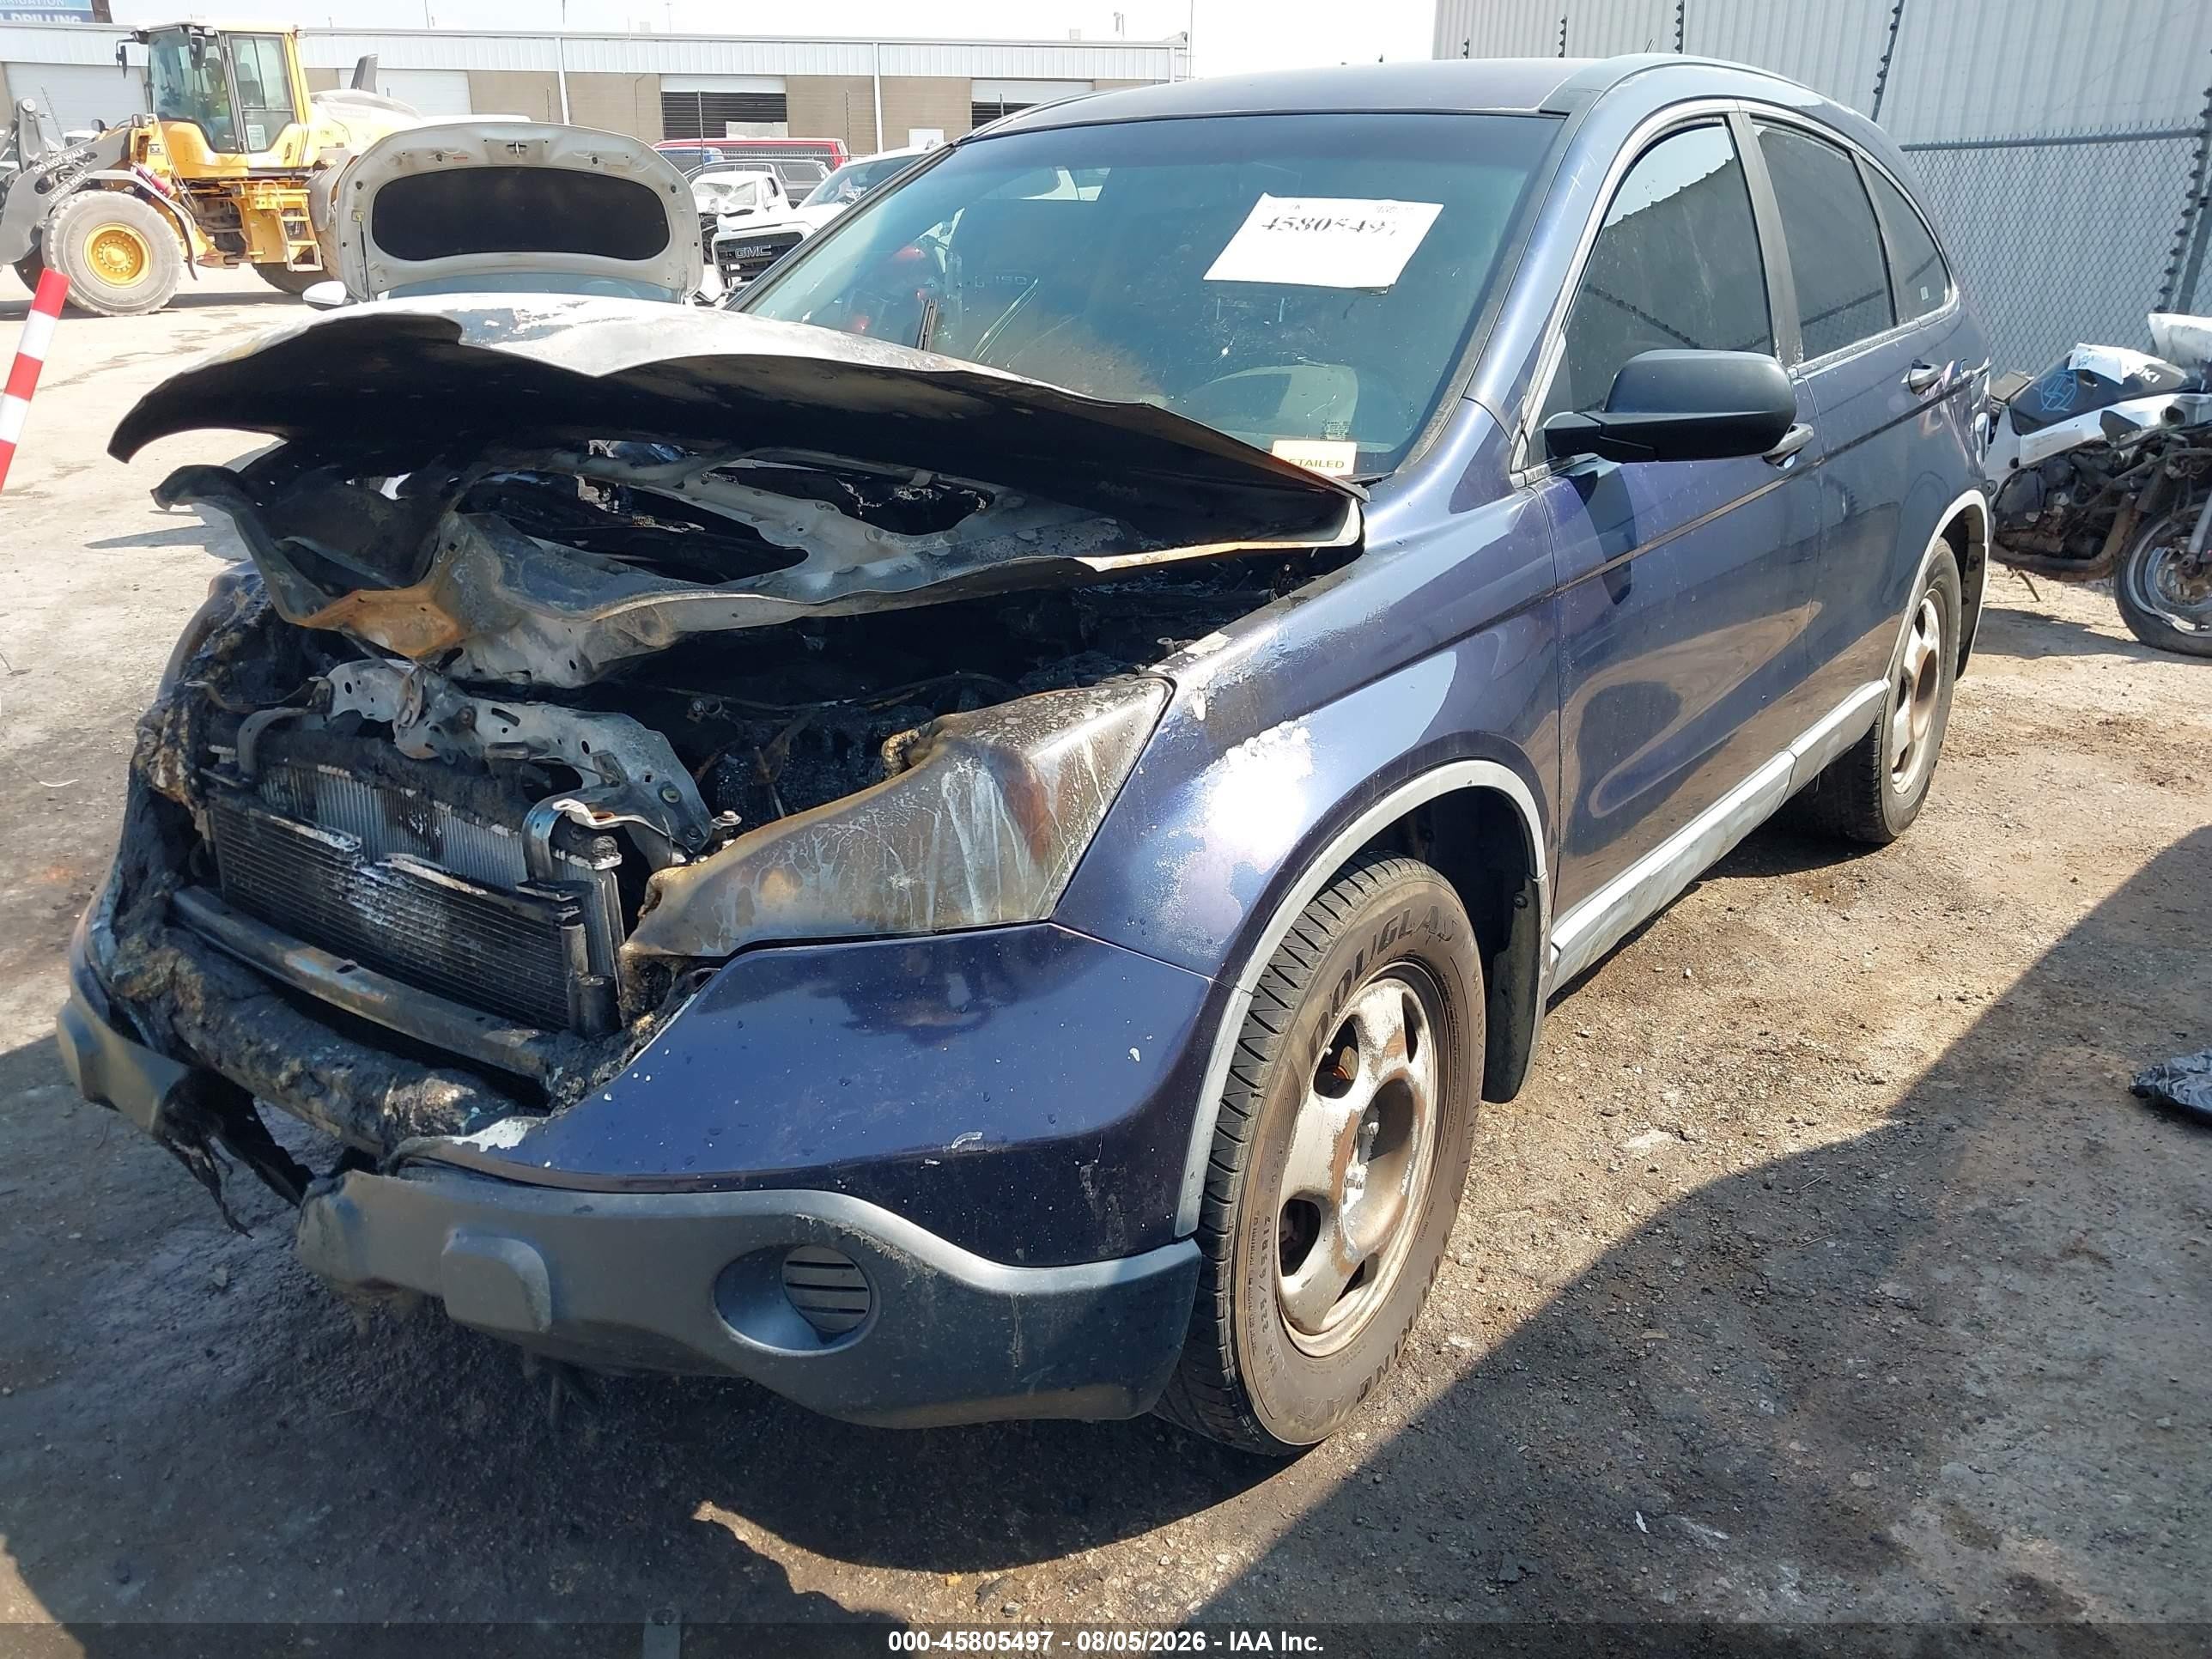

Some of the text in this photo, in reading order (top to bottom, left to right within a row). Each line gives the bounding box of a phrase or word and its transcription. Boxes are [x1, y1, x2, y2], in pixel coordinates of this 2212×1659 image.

[33, 148, 88, 173] DO NOT WALK
[48, 170, 88, 203] UNDER MAST
[735, 245, 772, 258] GMC
[1308, 905, 1458, 1070] DOUGLAS
